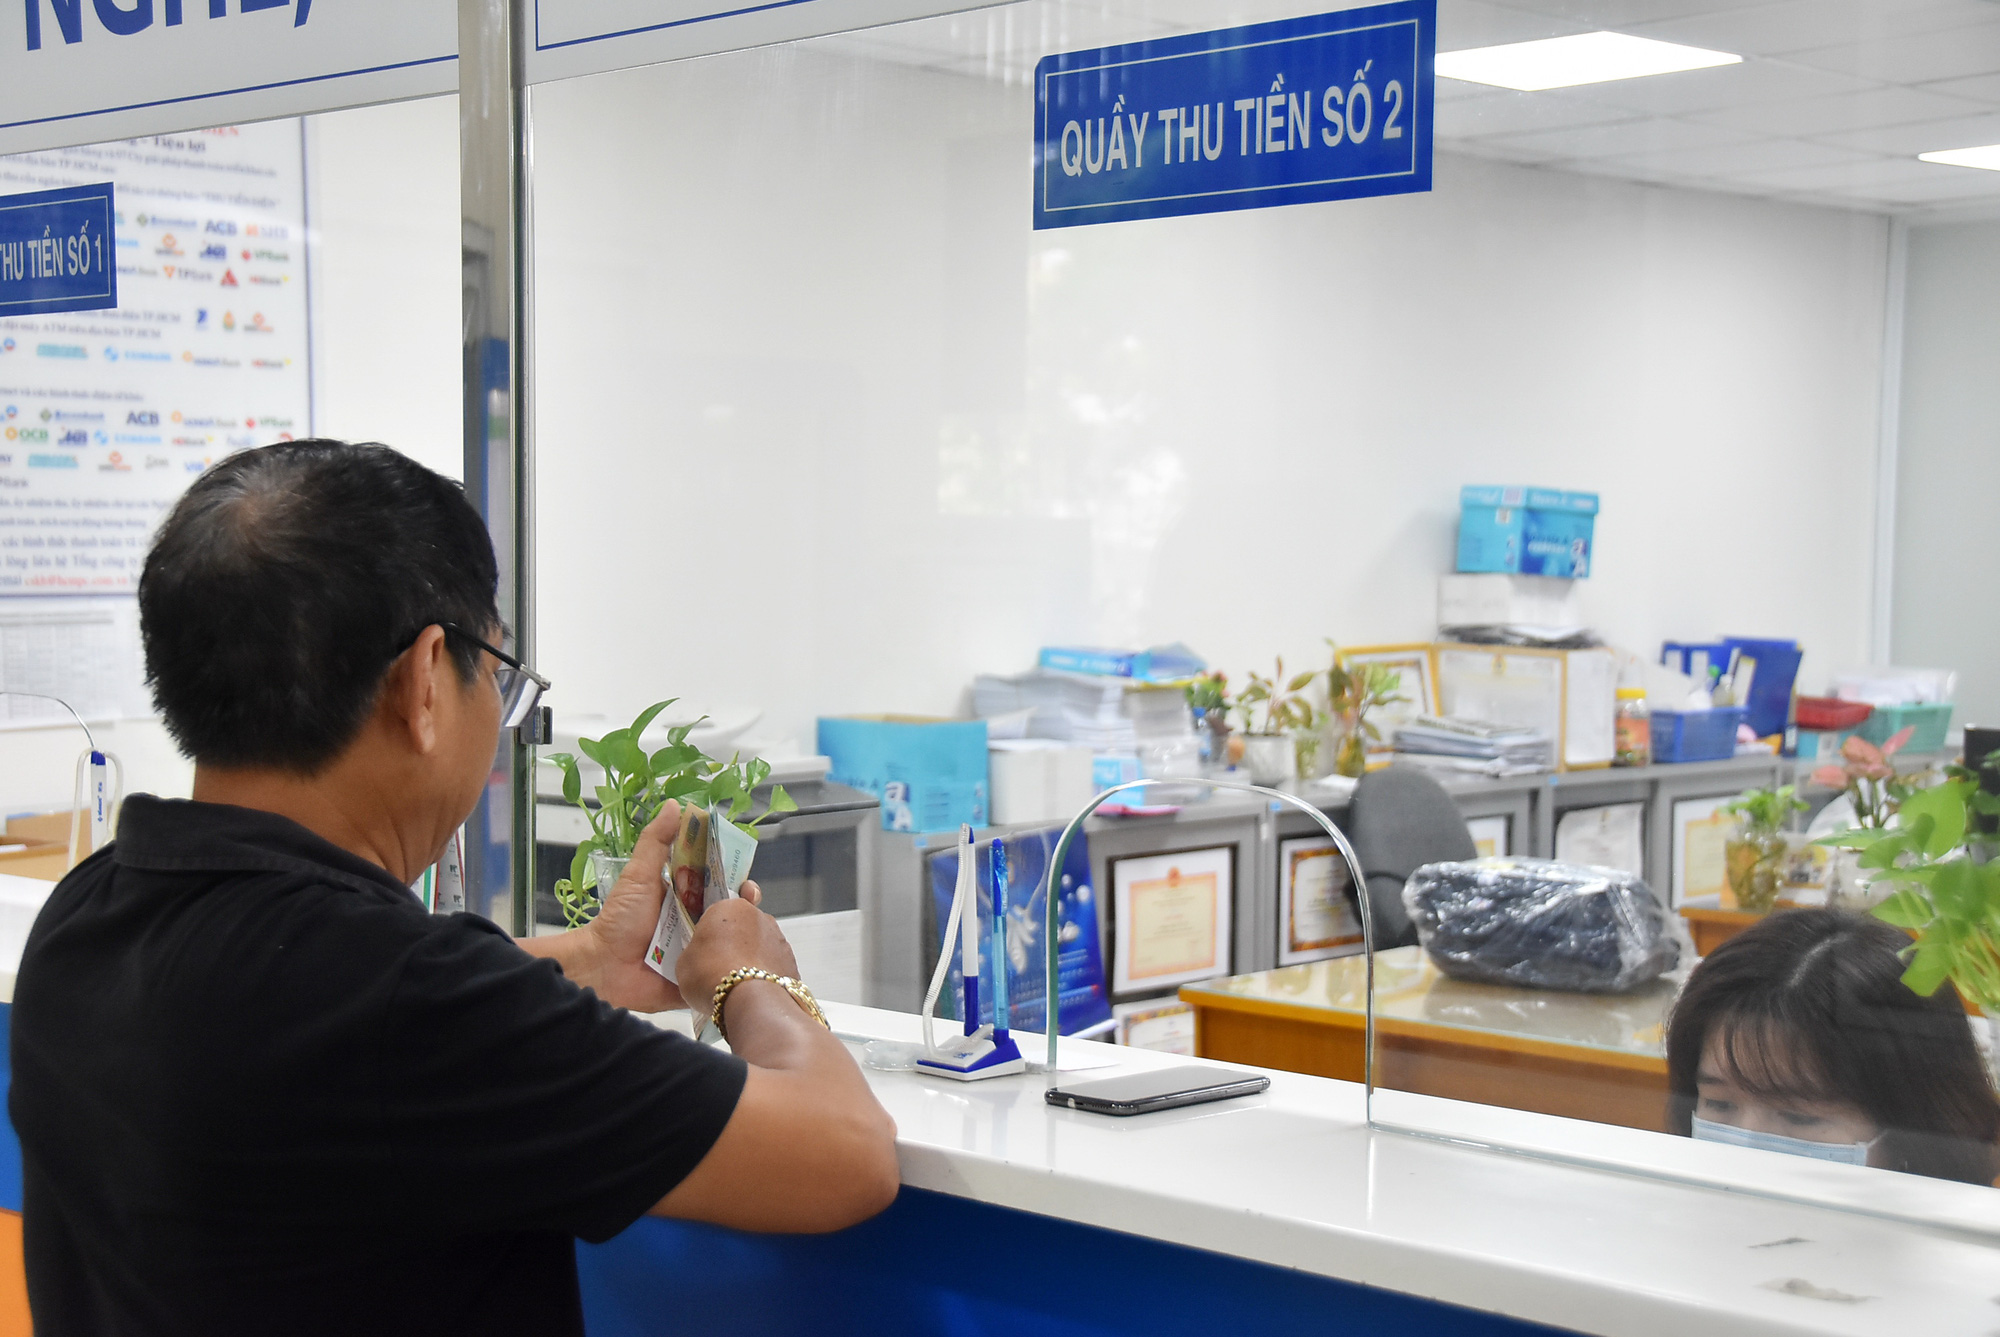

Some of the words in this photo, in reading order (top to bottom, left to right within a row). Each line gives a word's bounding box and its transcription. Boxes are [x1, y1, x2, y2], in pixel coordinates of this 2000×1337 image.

[1060, 95, 1149, 178] QUẦY
[1158, 102, 1224, 165] THU
[1233, 73, 1312, 156] TIỀN
[1321, 60, 1373, 148] SỐ
[1383, 79, 1402, 140] 2
[0, 241, 24, 281] HU
[28, 225, 63, 279] TIỀN
[68, 219, 91, 276] SỐ
[95, 233, 101, 272] 1
[126, 411, 160, 426] ACB
